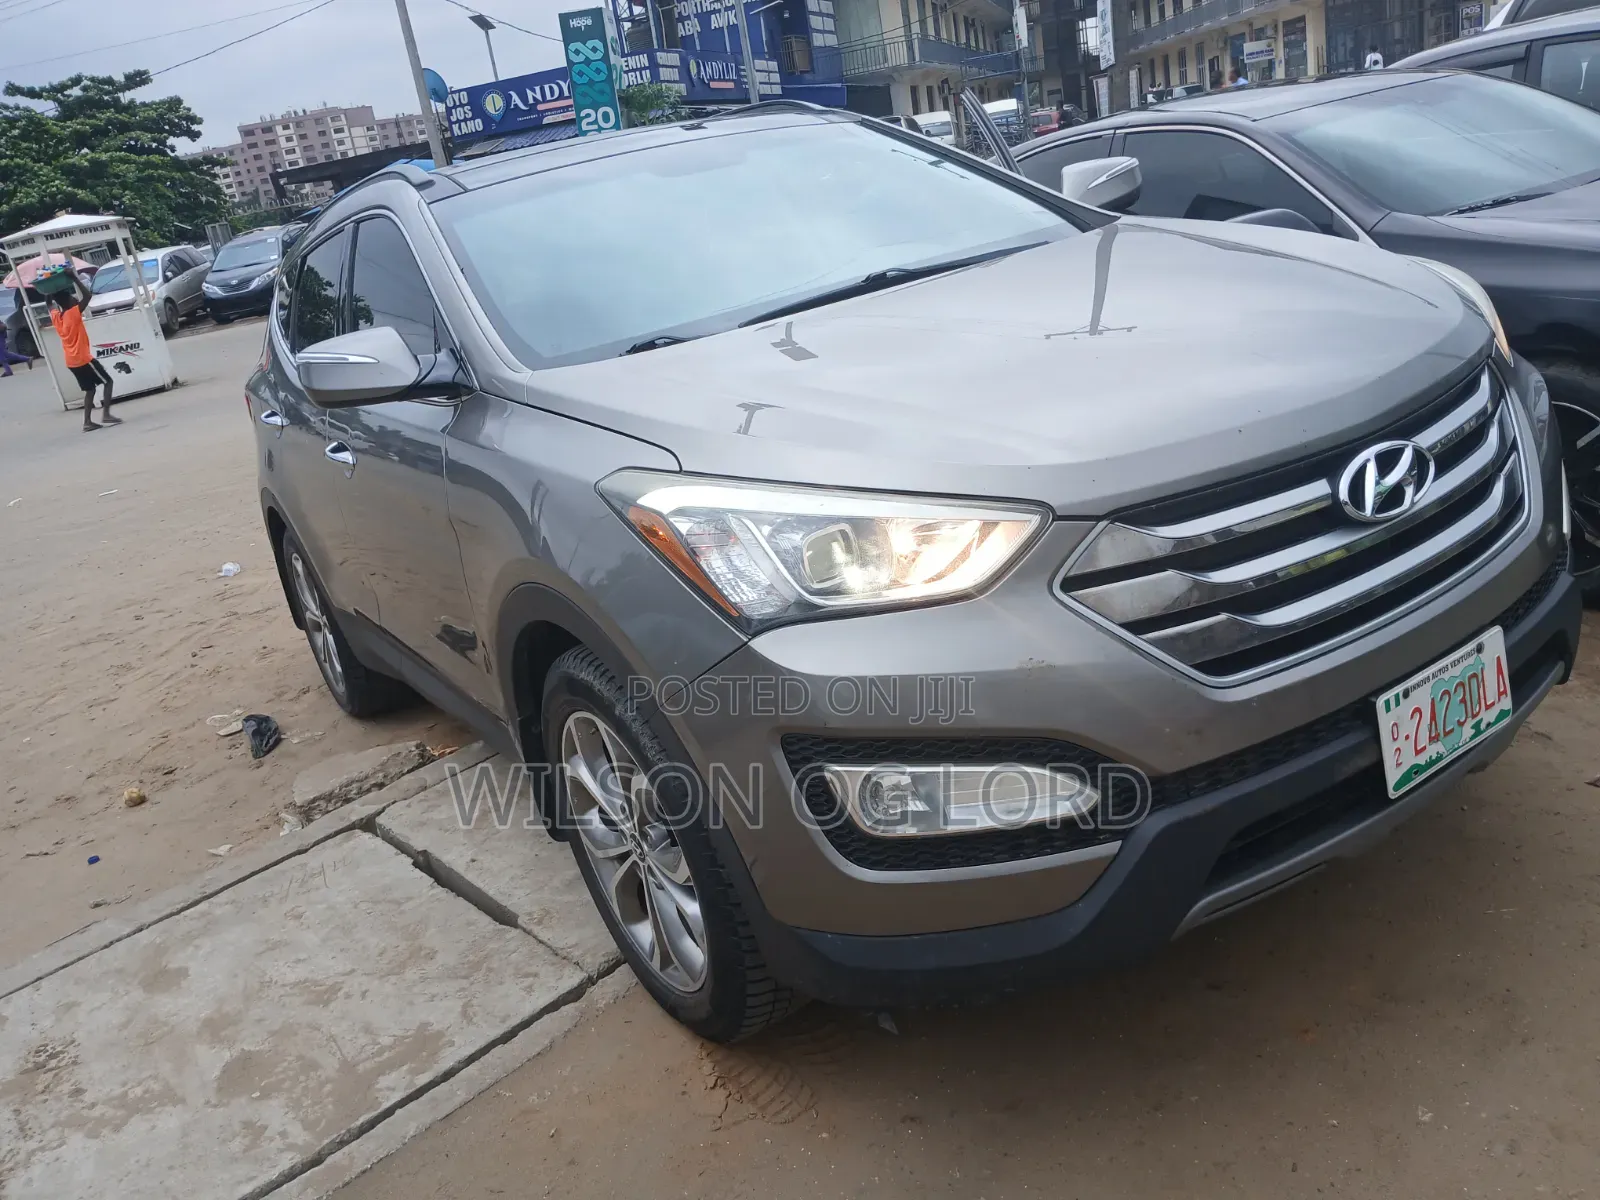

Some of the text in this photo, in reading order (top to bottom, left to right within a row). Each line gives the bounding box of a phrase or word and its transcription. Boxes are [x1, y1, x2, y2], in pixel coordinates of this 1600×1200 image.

[1462, 5, 1481, 15] POS
[569, 17, 593, 32] Hope
[677, 18, 701, 38] ABA
[620, 53, 649, 71] ENIN
[698, 59, 738, 84] ANDYLIZ
[446, 91, 469, 108] OYO
[507, 79, 571, 110] ANDY
[450, 105, 473, 122] JOS
[580, 106, 616, 131] 20
[452, 118, 484, 137] KANO
[44, 230, 76, 241] TRAFFIC
[79, 223, 111, 235] OFFICER
[96, 342, 141, 358] MIKANO
[1431, 664, 1449, 681] AUTOS
[1450, 647, 1476, 669] VENTURES
